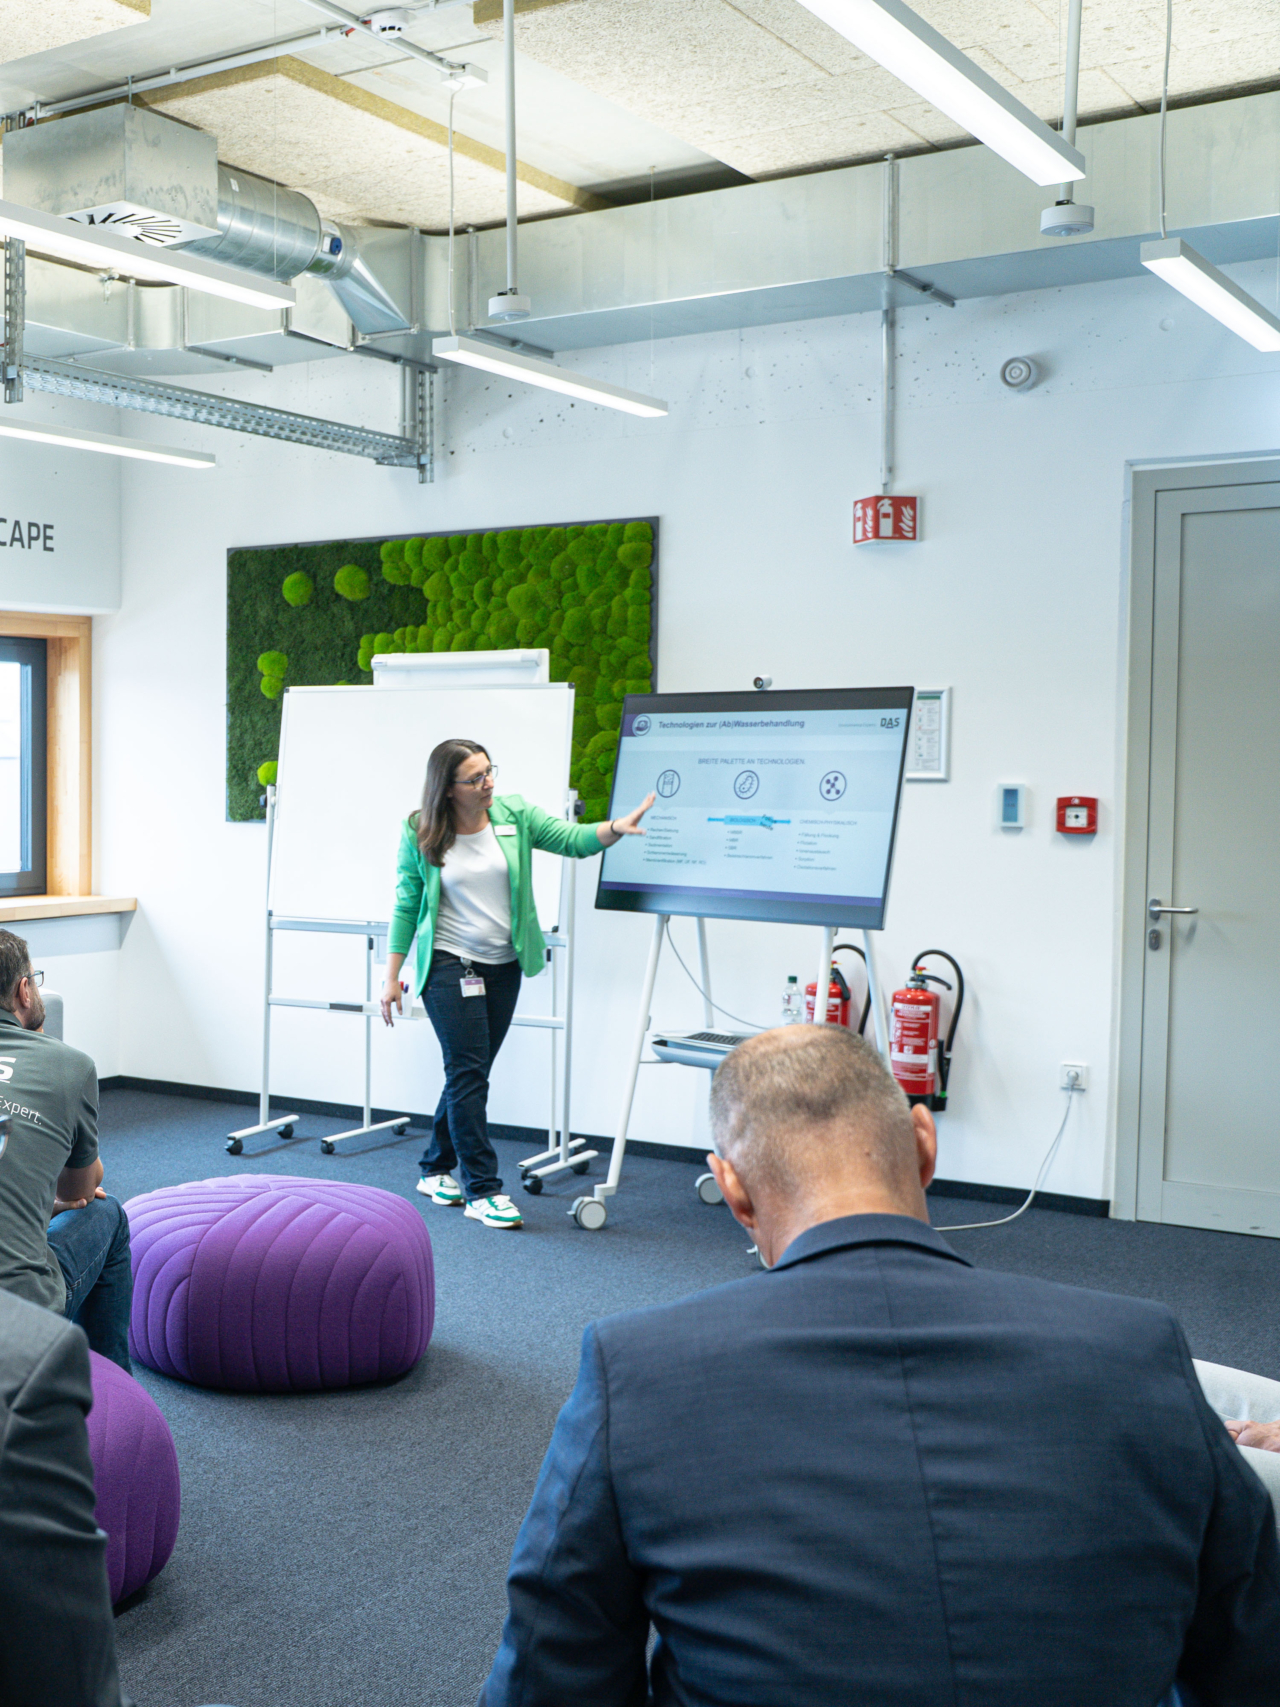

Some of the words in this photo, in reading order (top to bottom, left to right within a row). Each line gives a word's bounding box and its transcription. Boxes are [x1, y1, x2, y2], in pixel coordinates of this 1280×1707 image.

[658, 721, 704, 730] Technologien
[705, 721, 717, 729] zur
[719, 719, 805, 729] (Ab)Wasserbehandlung
[880, 717, 900, 729] DAS
